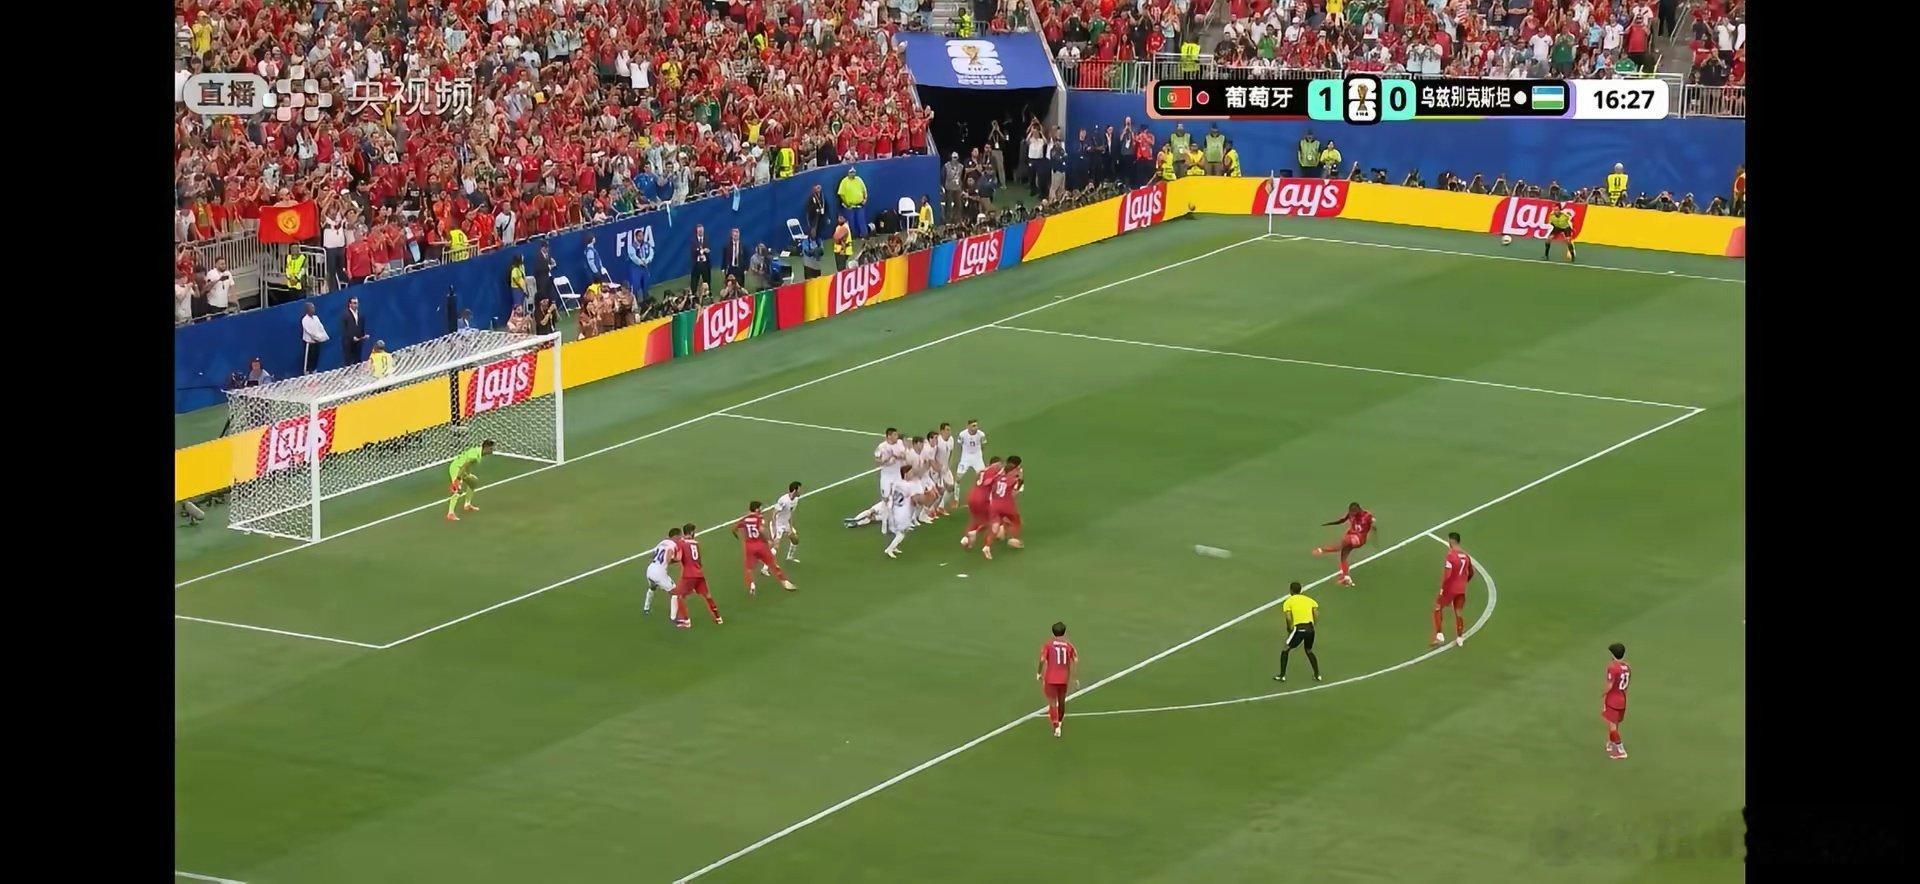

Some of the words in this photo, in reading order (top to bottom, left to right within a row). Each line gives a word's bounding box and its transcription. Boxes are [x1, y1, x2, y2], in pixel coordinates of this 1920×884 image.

[1264, 177, 1339, 216] Lay's
[1124, 185, 1162, 231] Lay's
[959, 232, 999, 276] Lay's
[745, 523, 760, 538] 15
[690, 543, 699, 560] 8
[1459, 558, 1467, 576] 7
[1055, 646, 1067, 665] 11
